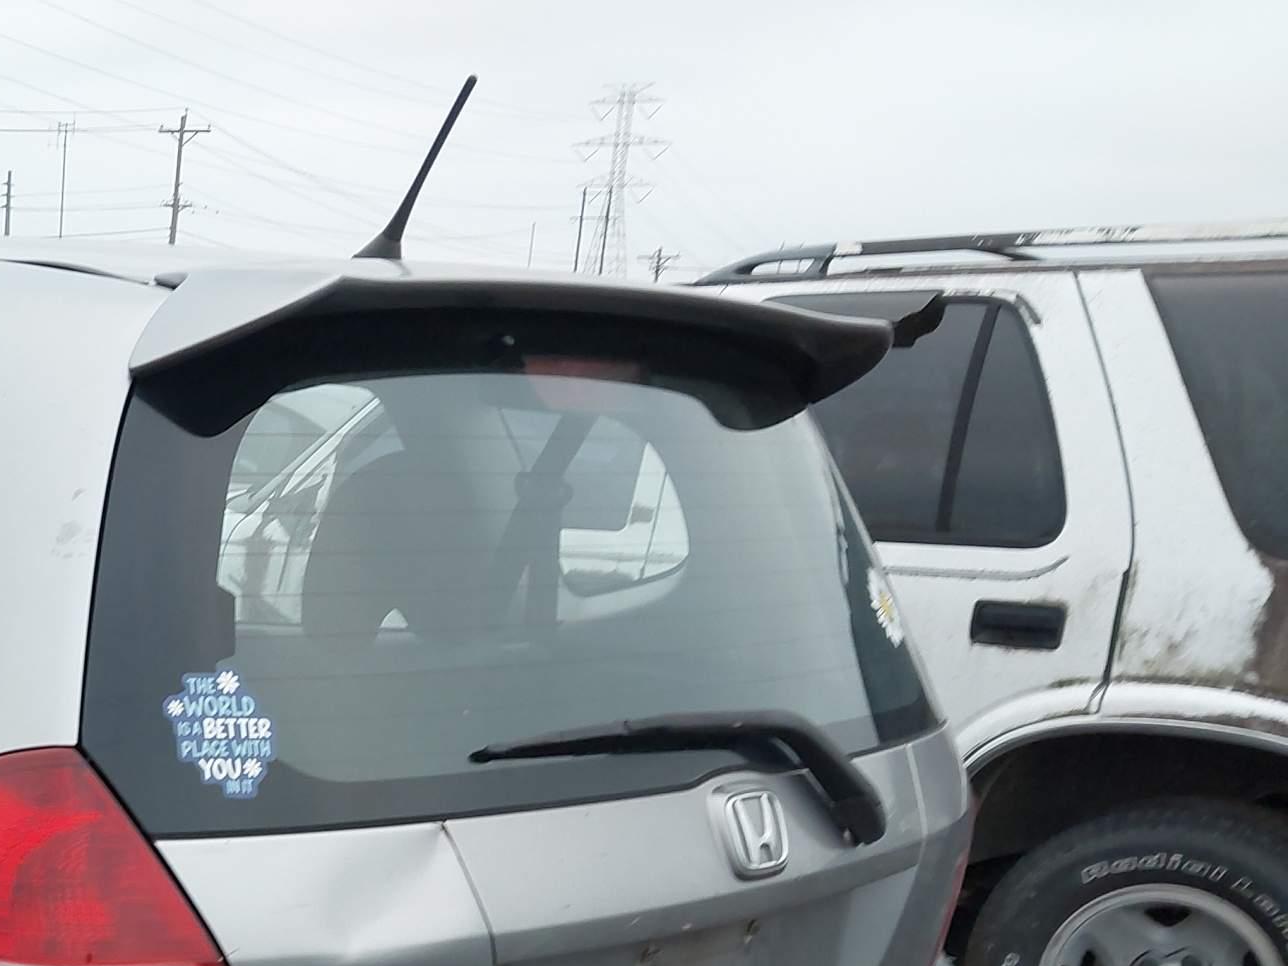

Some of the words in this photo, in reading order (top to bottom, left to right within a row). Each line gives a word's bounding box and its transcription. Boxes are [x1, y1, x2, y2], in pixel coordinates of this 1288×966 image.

[186, 677, 216, 694] THE
[183, 696, 255, 717] WORLD
[202, 717, 272, 739] BETTER
[181, 740, 229, 758] PLACE
[231, 740, 272, 758] WITH
[198, 758, 242, 780] YOU
[1080, 852, 1230, 885] Radial
